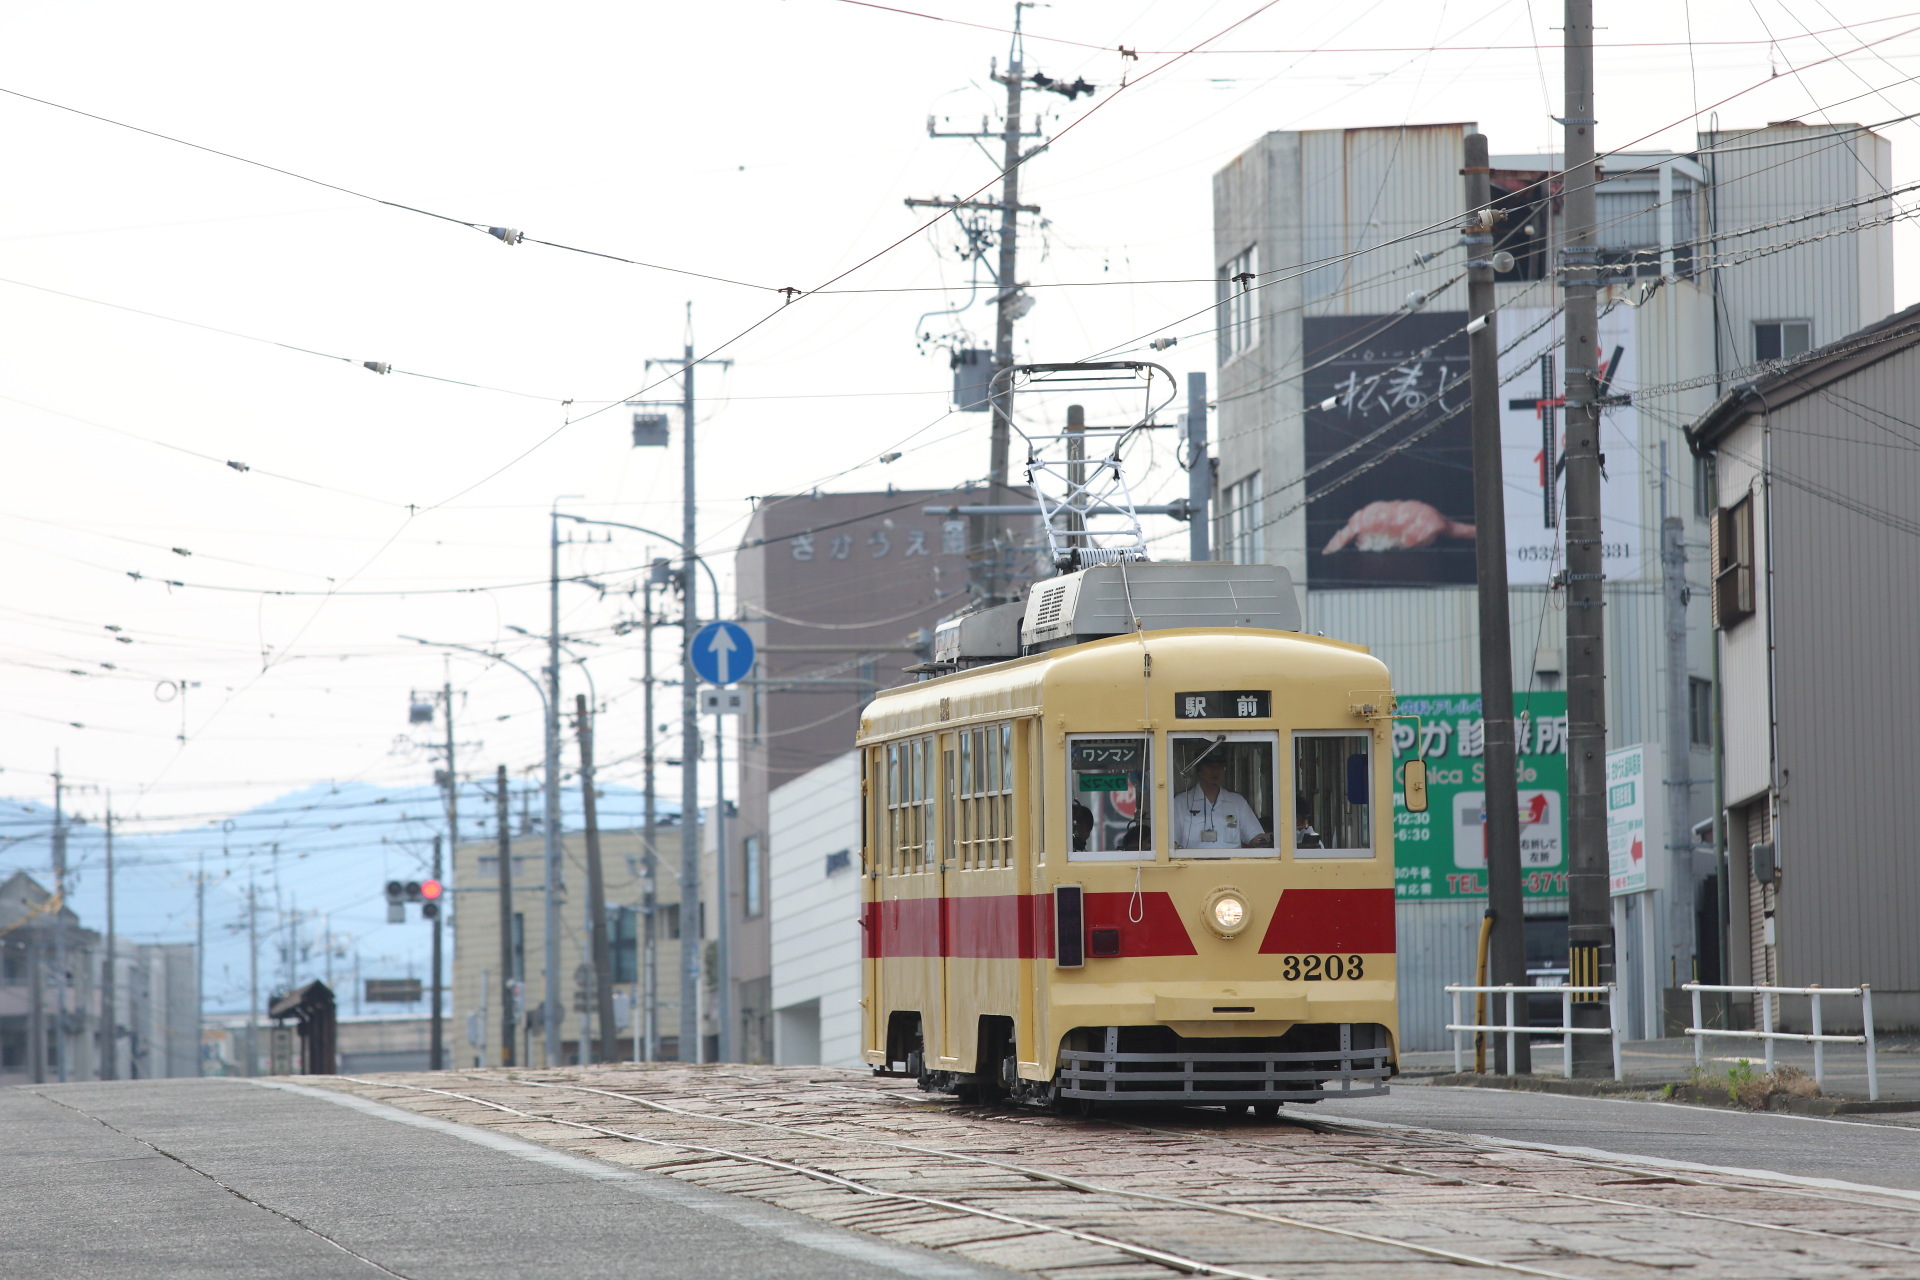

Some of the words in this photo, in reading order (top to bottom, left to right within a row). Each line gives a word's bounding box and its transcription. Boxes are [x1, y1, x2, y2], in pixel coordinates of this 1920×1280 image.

[1185, 695, 1258, 718] 駅前
[1082, 749, 1135, 761] ワンマン
[1283, 955, 1364, 981] 3203
